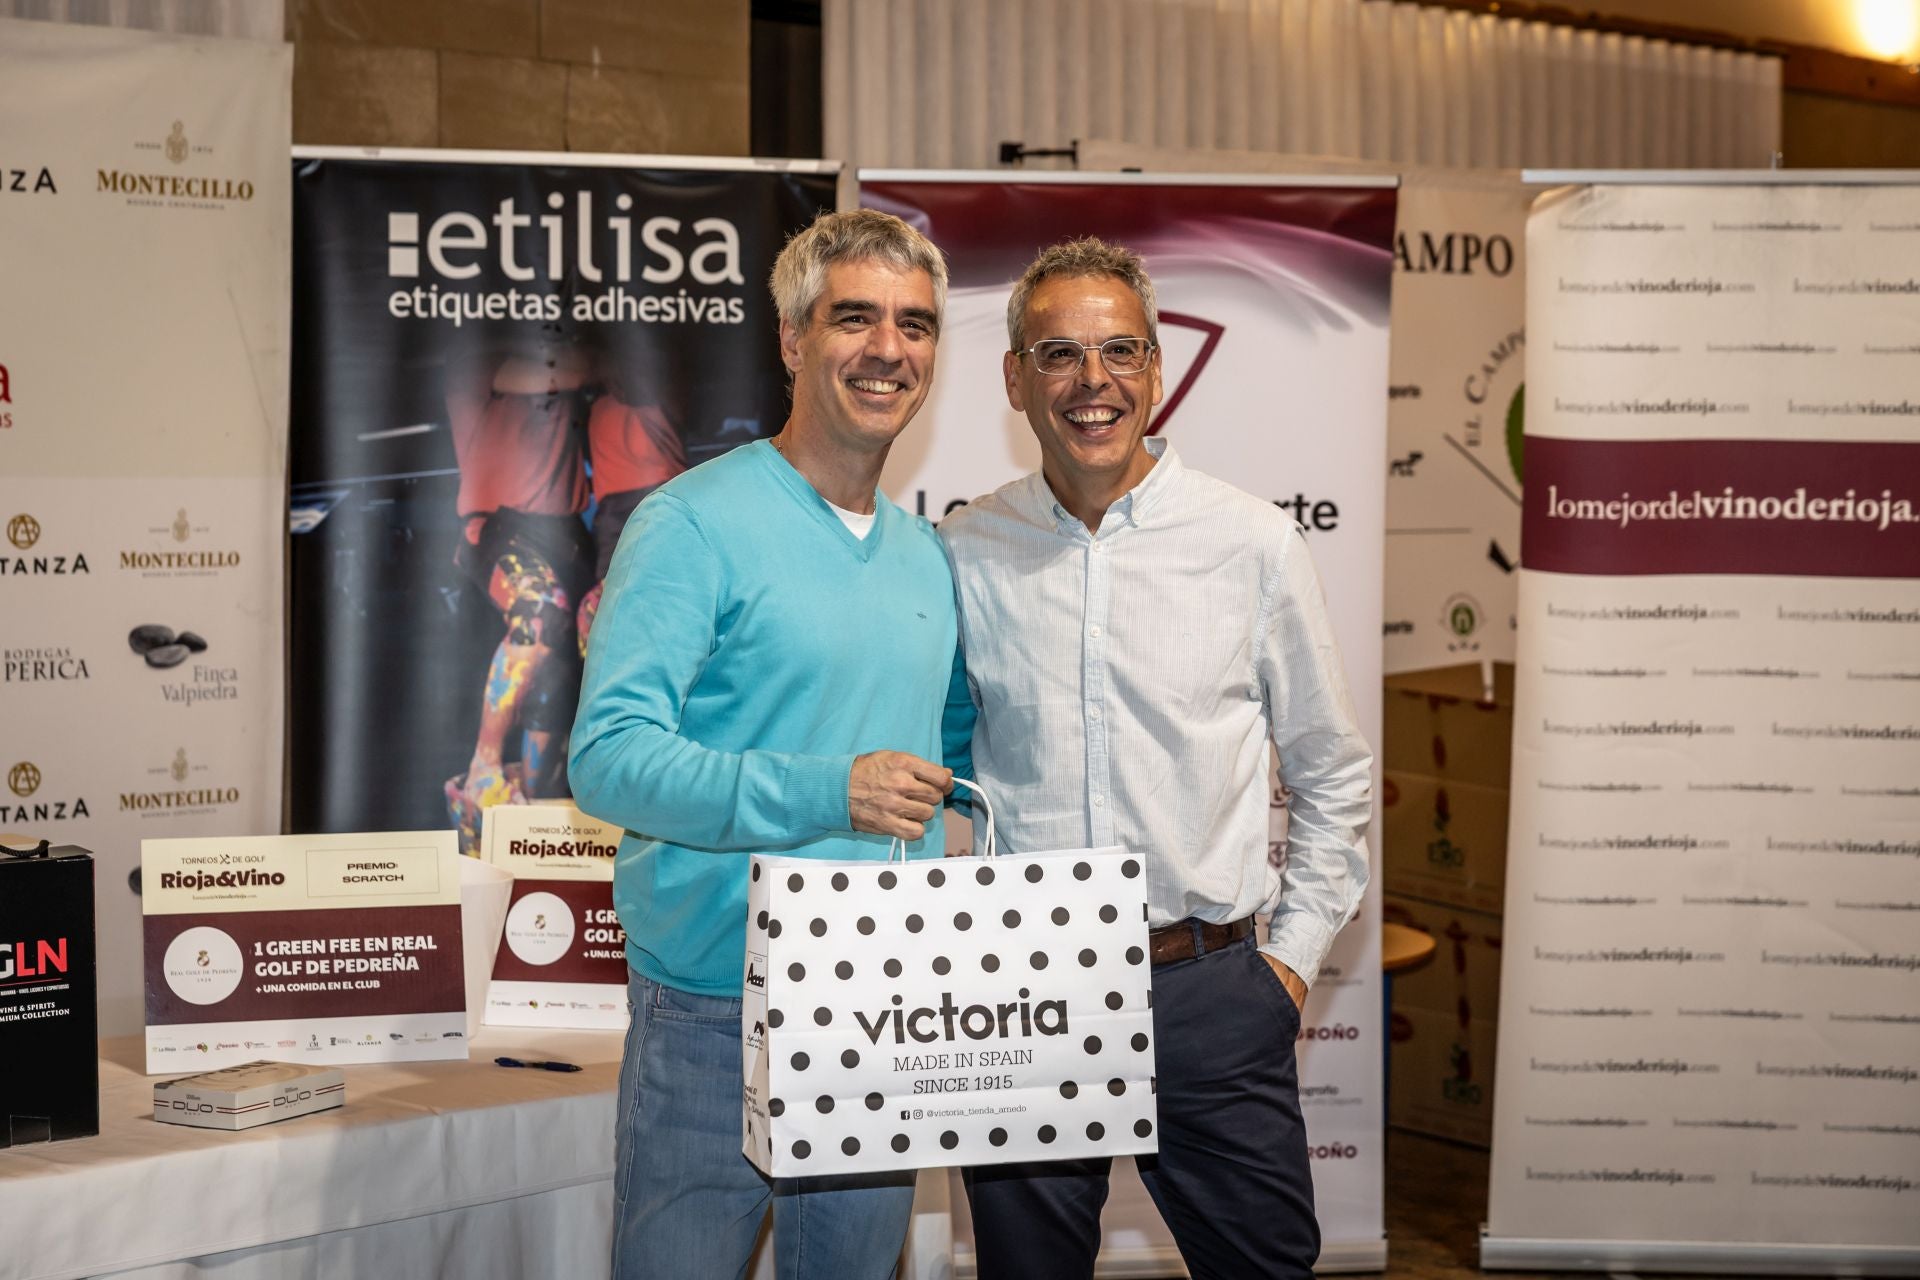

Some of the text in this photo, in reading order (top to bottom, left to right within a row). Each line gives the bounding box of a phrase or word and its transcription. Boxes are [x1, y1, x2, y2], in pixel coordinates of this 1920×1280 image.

[97, 169, 254, 201] MONTECILLO
[427, 191, 744, 285] etilisa
[389, 284, 744, 326] etiquetas adhesivas
[1547, 484, 1920, 531] lomejordelvinoderioja.
[120, 551, 240, 570] MONTECILLO
[5, 660, 90, 682] PERICA
[194, 666, 238, 684] Finca
[162, 684, 238, 706] Valpiedra
[119, 788, 240, 811] MONTECILLO
[528, 827, 602, 836] TORNEOS DE GOLF
[509, 840, 618, 859] Rioja&Vino
[181, 855, 266, 865] TORNEOS DE GOLF
[161, 868, 285, 891] Rioja&Vino
[342, 874, 404, 883] SCRATCH
[585, 910, 593, 923] 1
[254, 935, 437, 956] 1 GREEN FEE EN REAL
[584, 929, 626, 943] GOLF
[590, 950, 610, 959] UNA
[255, 952, 419, 977] GOLF DE PEDREÑA
[263, 983, 286, 992] UNA
[287, 982, 327, 992] COMIDA
[328, 981, 342, 990] EN
[343, 981, 353, 990] EL
[355, 980, 380, 990] CLUB
[22, 1008, 70, 1019] COLLECTION
[27, 1002, 56, 1010] SPIRITS
[853, 987, 1069, 1046] victoria
[893, 1050, 1033, 1071] MADE IN SPAIN
[913, 1074, 1013, 1094] SINCE 1915
[173, 1100, 213, 1113] DUO
[274, 1091, 311, 1107] DUO
